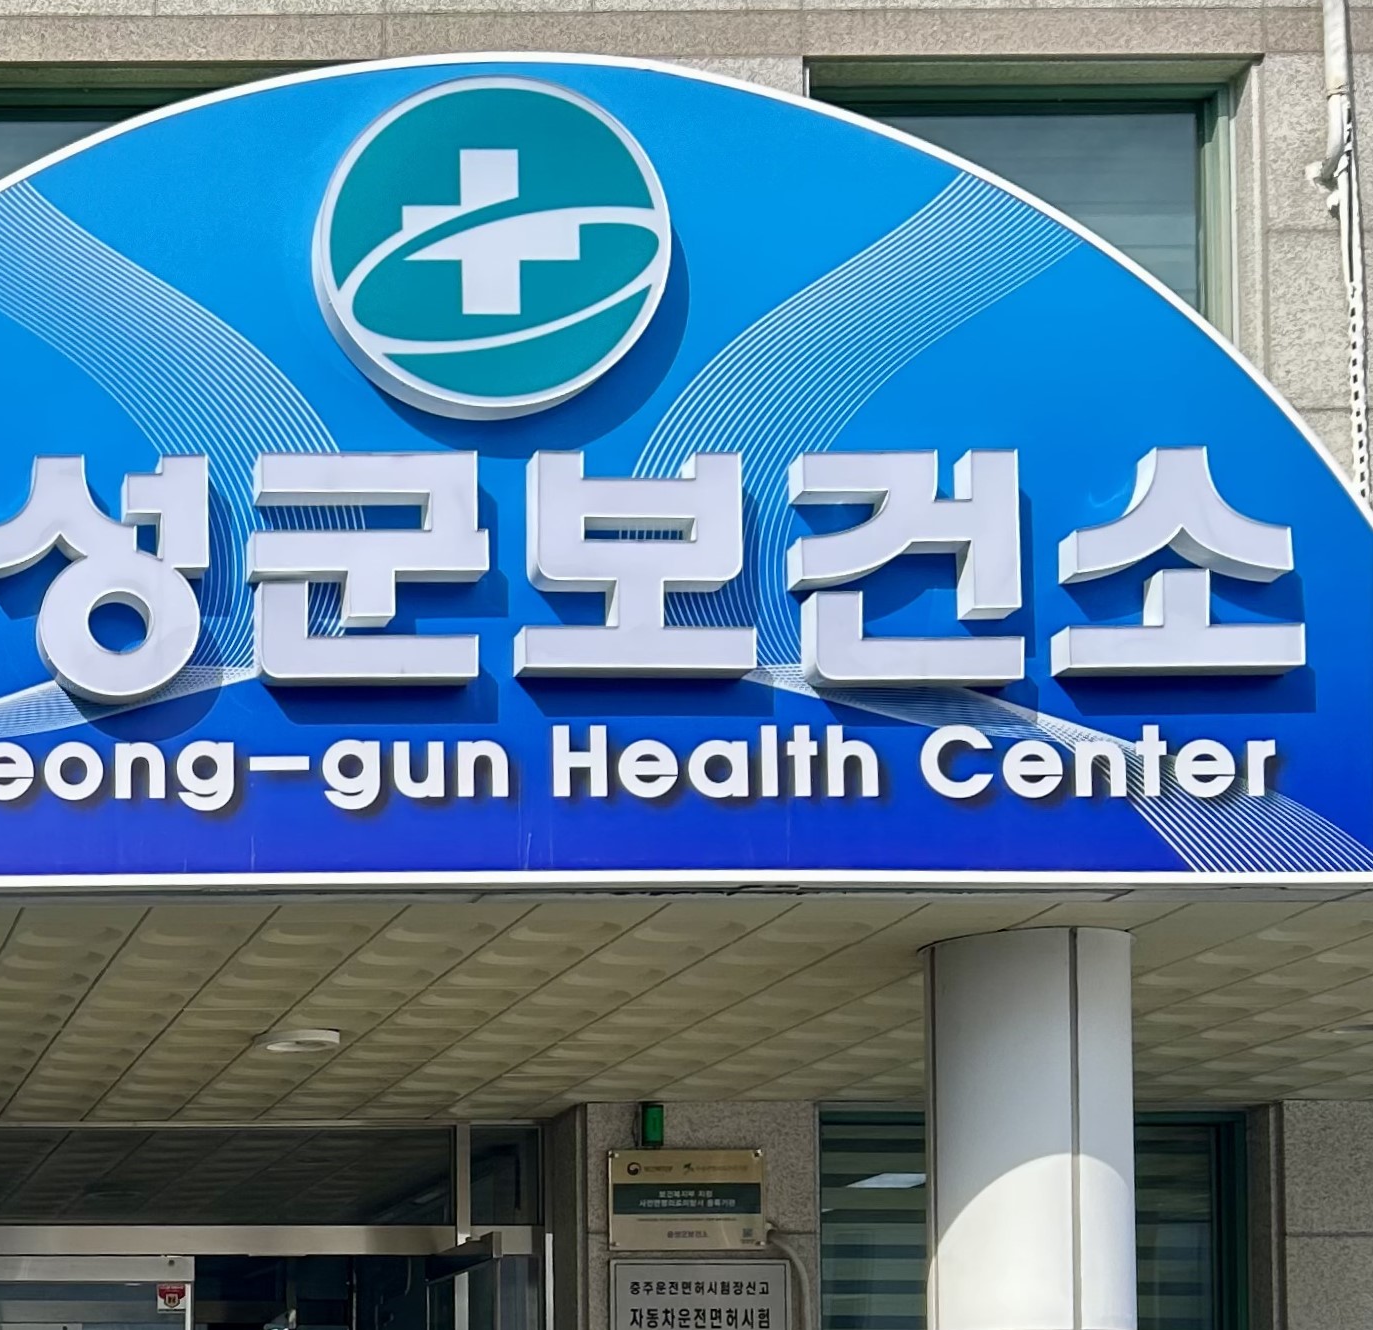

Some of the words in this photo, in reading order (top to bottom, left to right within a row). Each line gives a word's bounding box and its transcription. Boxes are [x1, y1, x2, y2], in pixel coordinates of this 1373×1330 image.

[552, 725, 880, 799] Health
[920, 723, 1276, 799] Center
[629, 1281, 770, 1295] 충주운전면허시험장신고
[629, 1308, 770, 1329] 자동차운전면허시험
